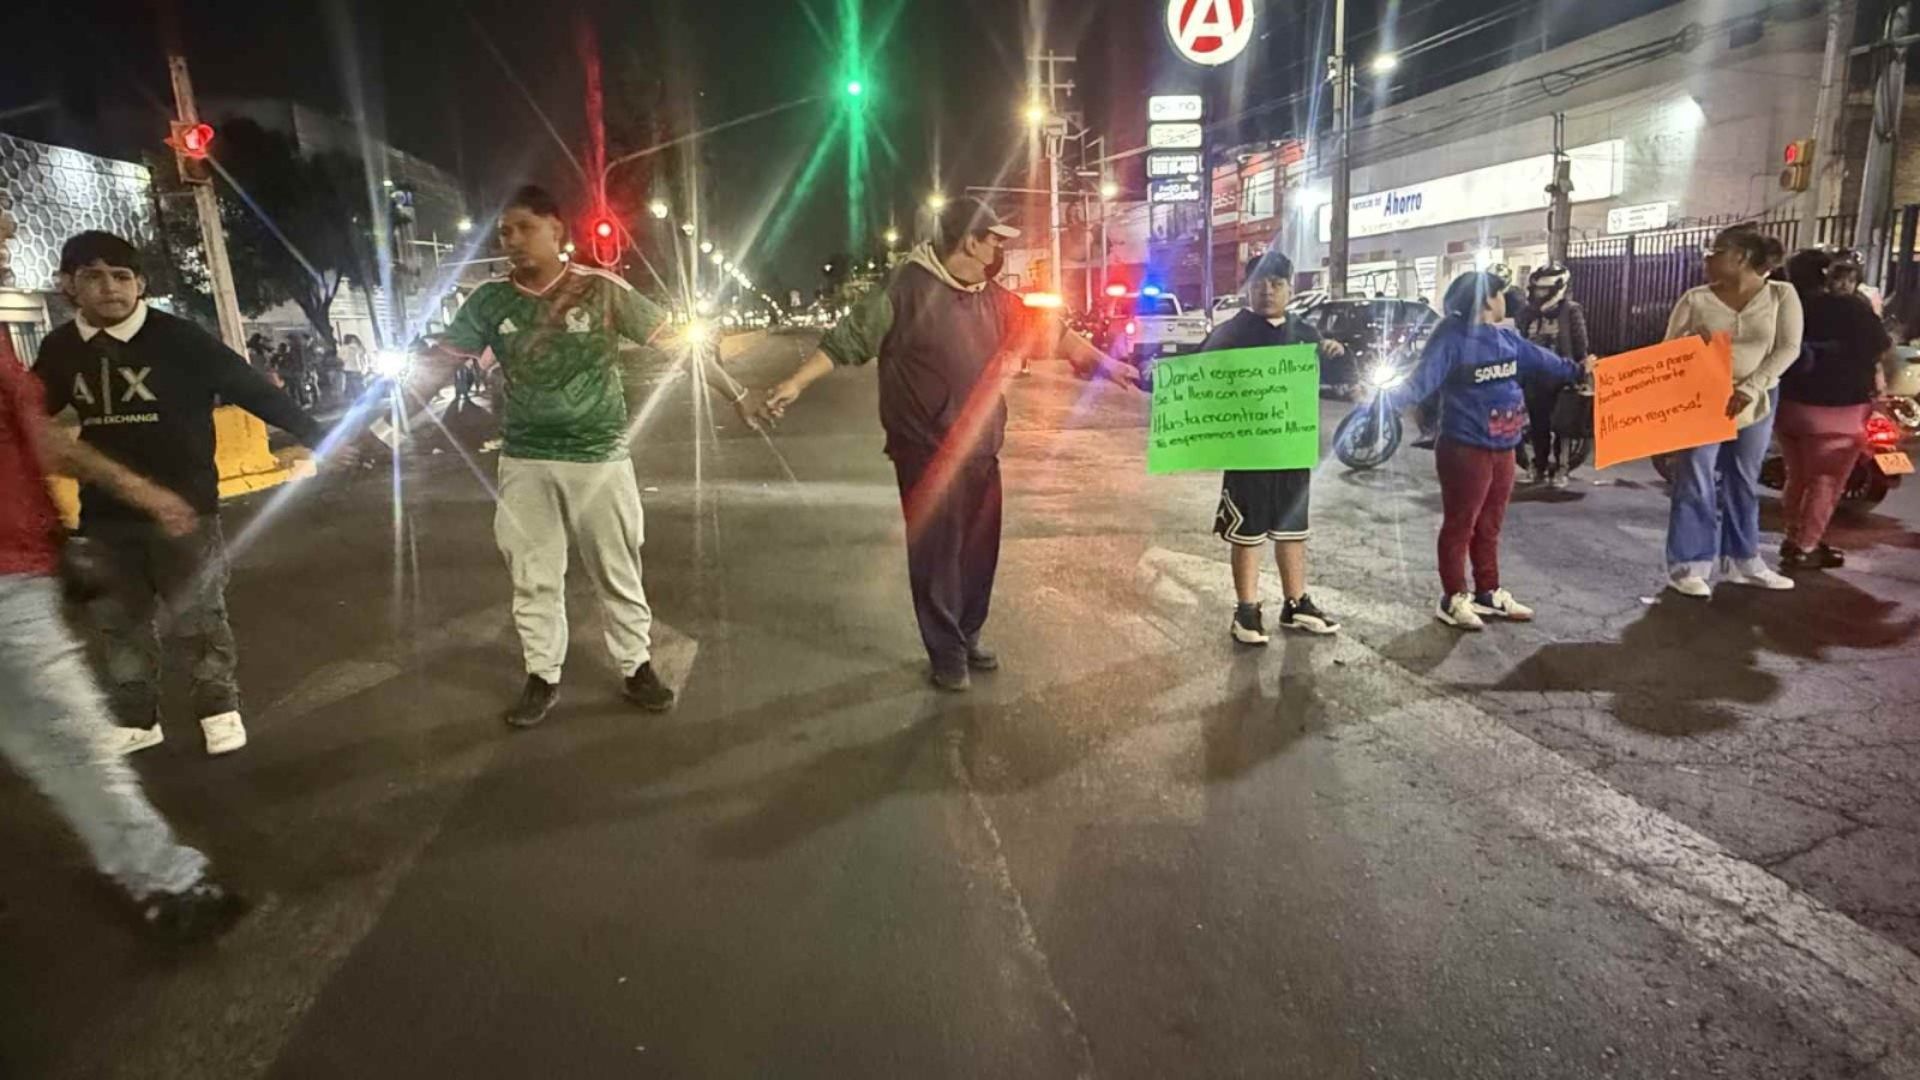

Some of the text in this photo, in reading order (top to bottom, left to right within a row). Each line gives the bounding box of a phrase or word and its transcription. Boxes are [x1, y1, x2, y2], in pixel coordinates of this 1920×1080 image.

[1383, 191, 1422, 216] Ahorro
[1158, 362, 1205, 388] Daniel
[1210, 366, 1263, 385] regresa
[1268, 366, 1277, 376] a
[1599, 373, 1615, 387] No
[1618, 363, 1655, 382] vamos
[1656, 360, 1664, 370] a
[1624, 367, 1686, 395] encontrarte
[1215, 389, 1239, 400] con
[104, 413, 159, 424] EXCHANGE
[1599, 391, 1702, 440] Allison regresa!
[1237, 428, 1254, 438] en
